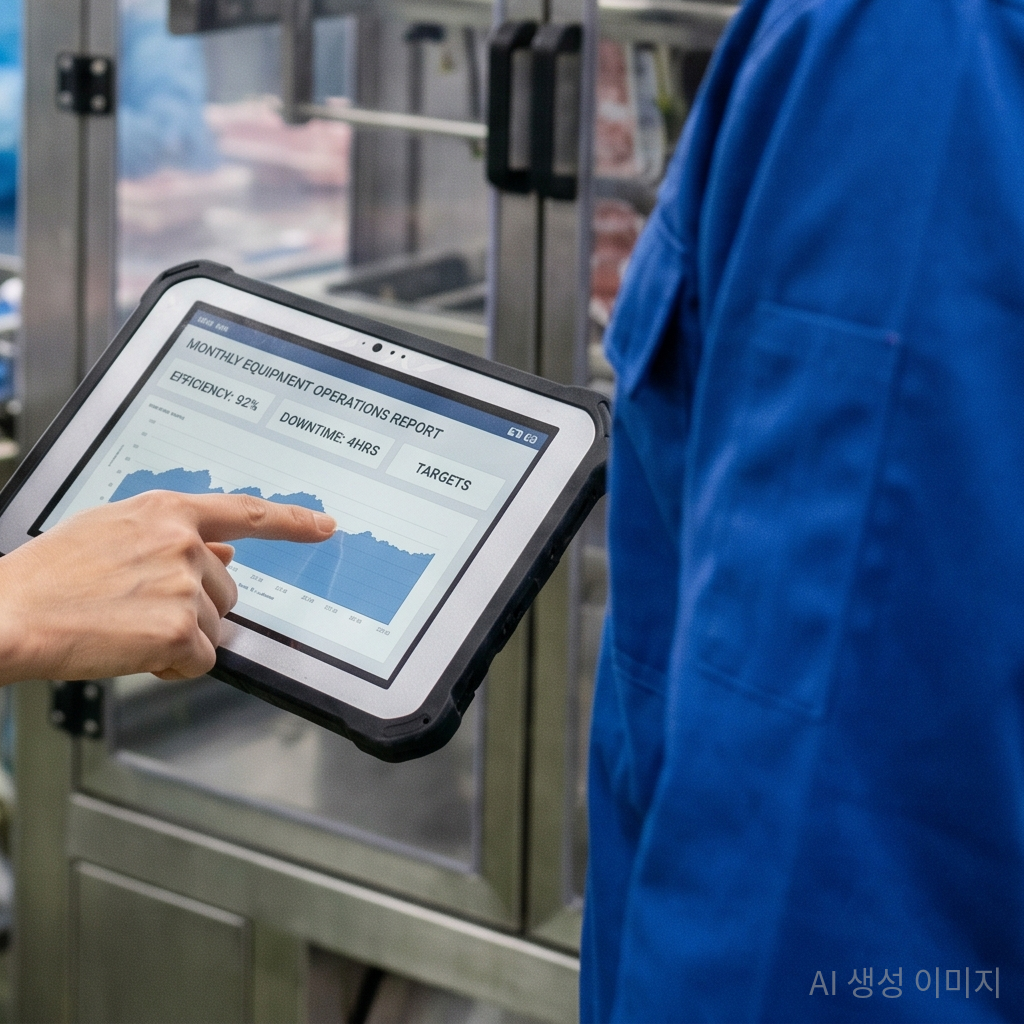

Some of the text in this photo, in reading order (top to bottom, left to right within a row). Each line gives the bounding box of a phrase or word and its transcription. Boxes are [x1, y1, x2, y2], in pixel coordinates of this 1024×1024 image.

[186, 338, 244, 366] MONTHLY
[313, 385, 391, 420] OPERATIONS
[389, 412, 444, 439] REPORT
[234, 394, 260, 411] 92%
[279, 412, 380, 456] DOWNTIME: 4HRS
[415, 462, 472, 491] TARGETS
